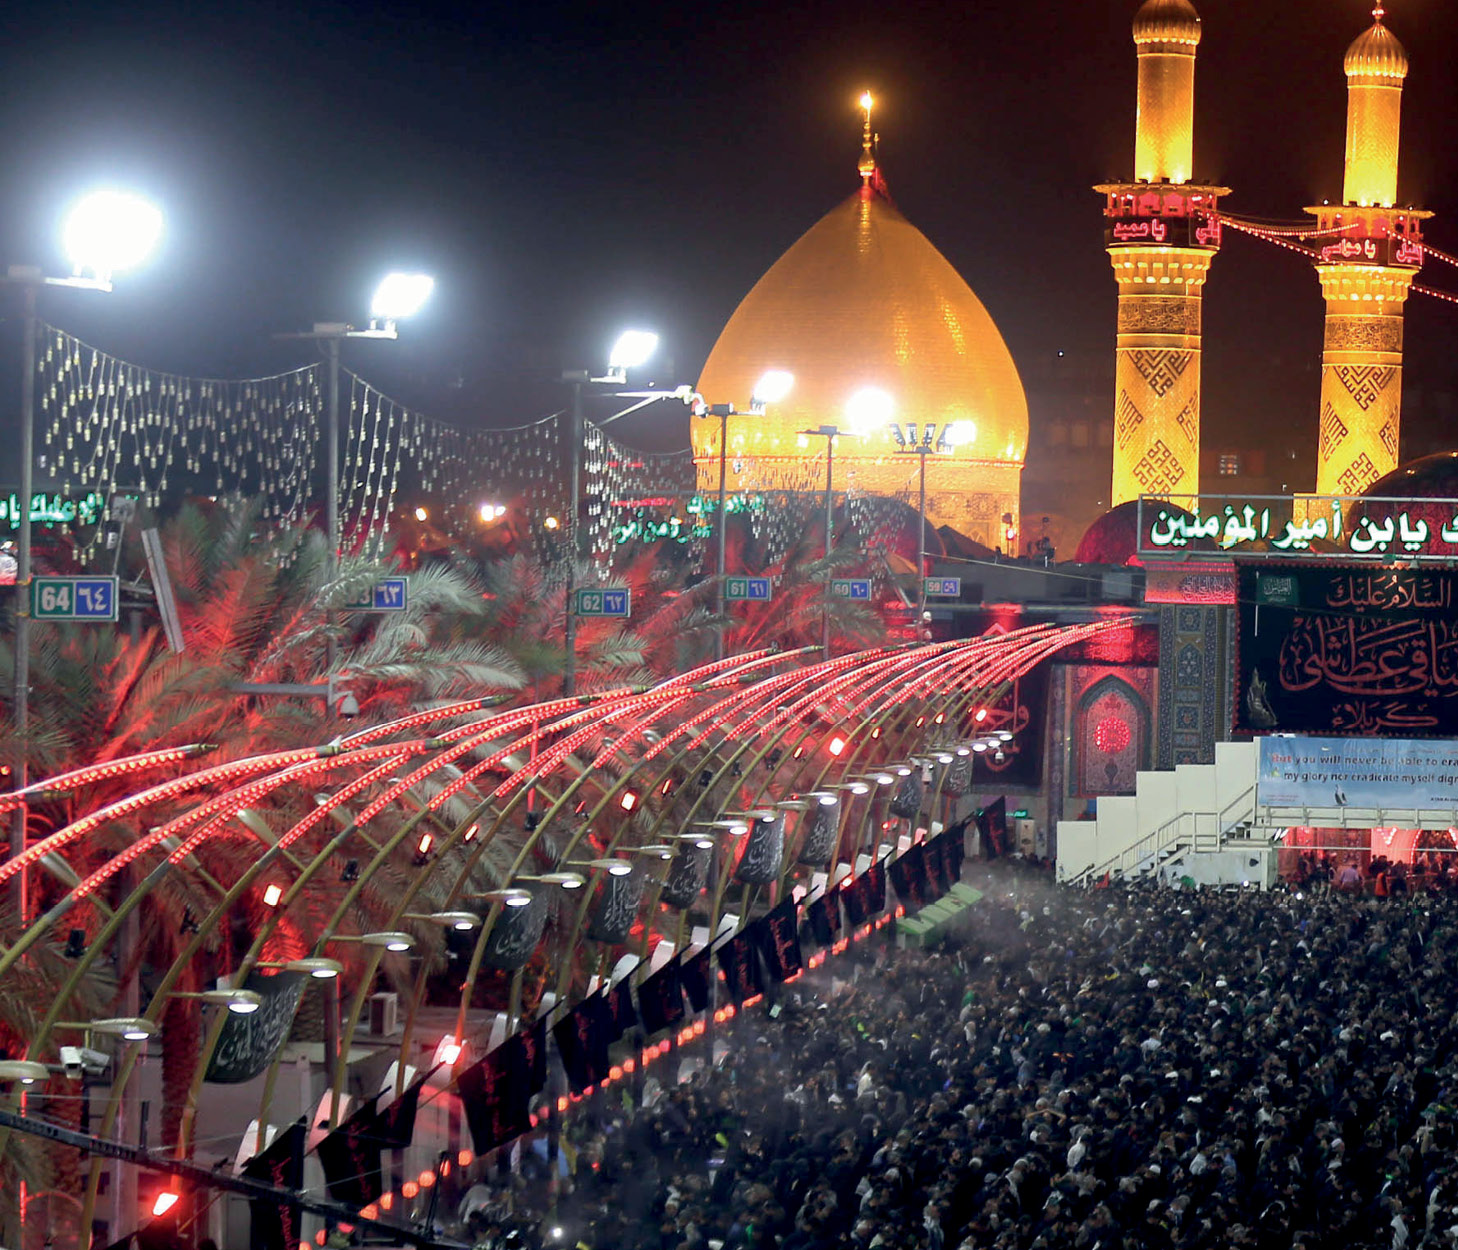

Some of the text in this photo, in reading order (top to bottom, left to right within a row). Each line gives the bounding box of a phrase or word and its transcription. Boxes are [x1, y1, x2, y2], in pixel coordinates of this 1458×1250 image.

[1150, 504, 1270, 547] المؤمنين
[1271, 500, 1343, 549] أمير
[376, 585, 400, 604] ٦٣
[730, 582, 745, 596] 61
[750, 583, 765, 596] ٦١
[41, 586, 70, 611] 64
[78, 587, 107, 611] ٦٤
[582, 595, 600, 611] 62
[606, 596, 623, 611] ٦٢
[1295, 757, 1316, 766] you
[1319, 755, 1341, 765] will
[1344, 757, 1377, 765] never
[1380, 756, 1394, 766] be
[1426, 757, 1438, 766] to
[1284, 772, 1299, 783] my
[1301, 772, 1328, 783] glory
[1331, 773, 1348, 781] nor
[1351, 772, 1399, 782] eradicate
[1401, 773, 1435, 784] myself
